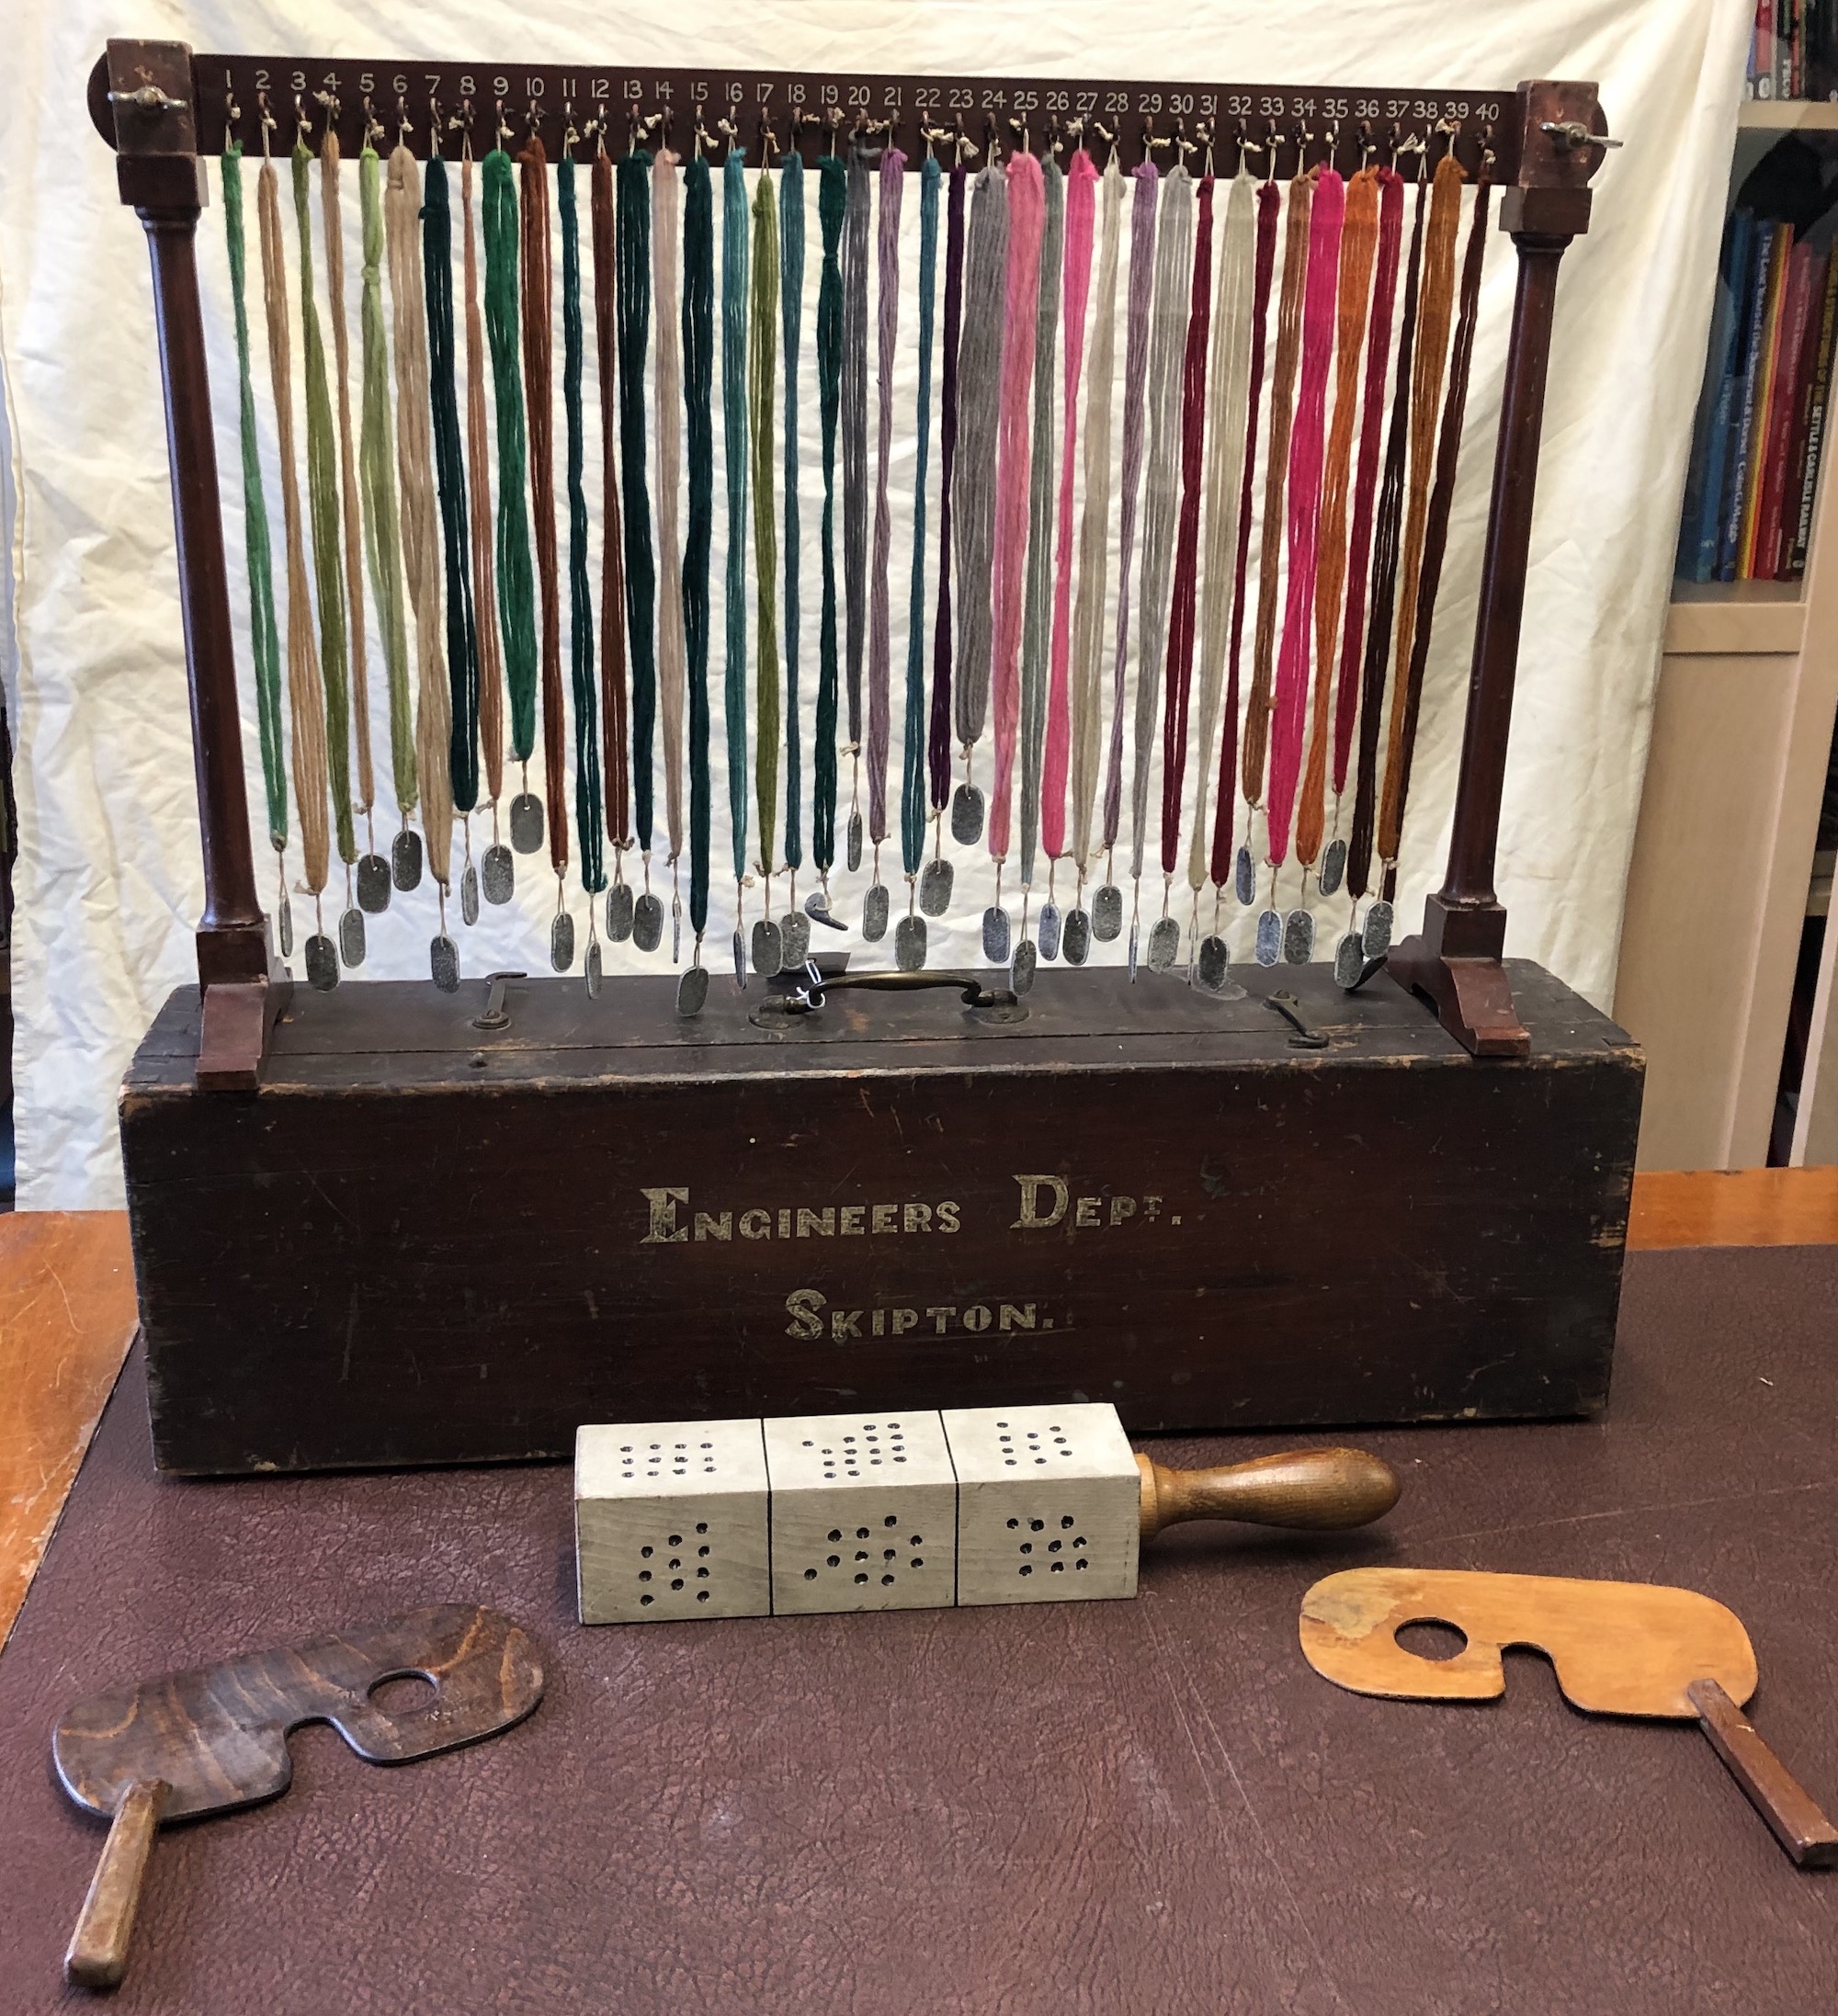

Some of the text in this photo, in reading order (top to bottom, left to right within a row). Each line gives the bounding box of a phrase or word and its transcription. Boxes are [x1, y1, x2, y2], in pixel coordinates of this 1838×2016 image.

[225, 70, 1500, 121] 1 2 3 4 5 6 7 8 9 10 11 12 13 14 15 16 17 18 19 20 21 22 23 24 25 26 27 28 29 30 31 32 33 34 35 36 37 38 39 40
[1740, 416, 1751, 454] Dorset
[1811, 405, 1822, 444] SETTLE
[1807, 445, 1818, 453] &
[1735, 460, 1747, 492] Colin
[1801, 453, 1817, 503] CARLISLE
[1797, 504, 1810, 549] RAILWAY
[640, 1186, 961, 1244] ENGINEERS
[784, 1288, 1055, 1341] SKIPTON.
